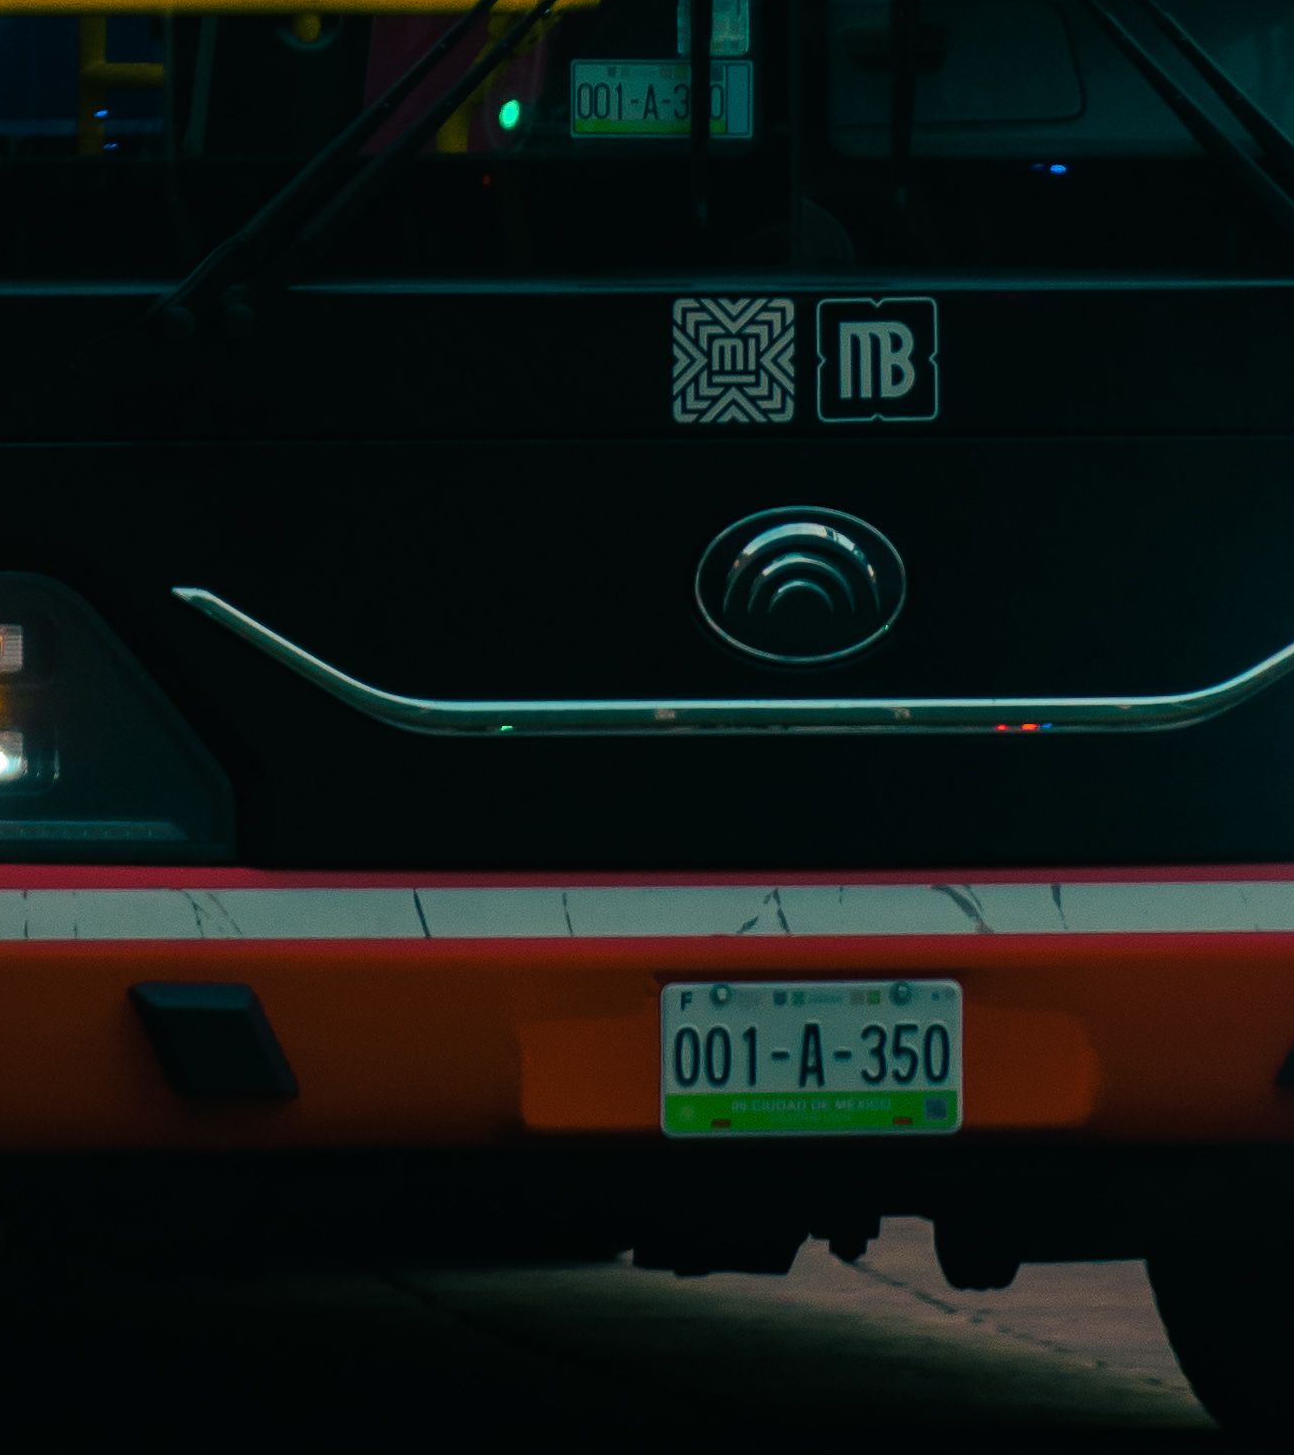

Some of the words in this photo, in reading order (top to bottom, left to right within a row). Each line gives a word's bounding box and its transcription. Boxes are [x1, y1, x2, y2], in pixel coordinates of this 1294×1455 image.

[577, 82, 725, 120] 001-A-30
[839, 321, 916, 400] MB
[680, 992, 692, 1010] F
[674, 1023, 950, 1087] 001-A-350
